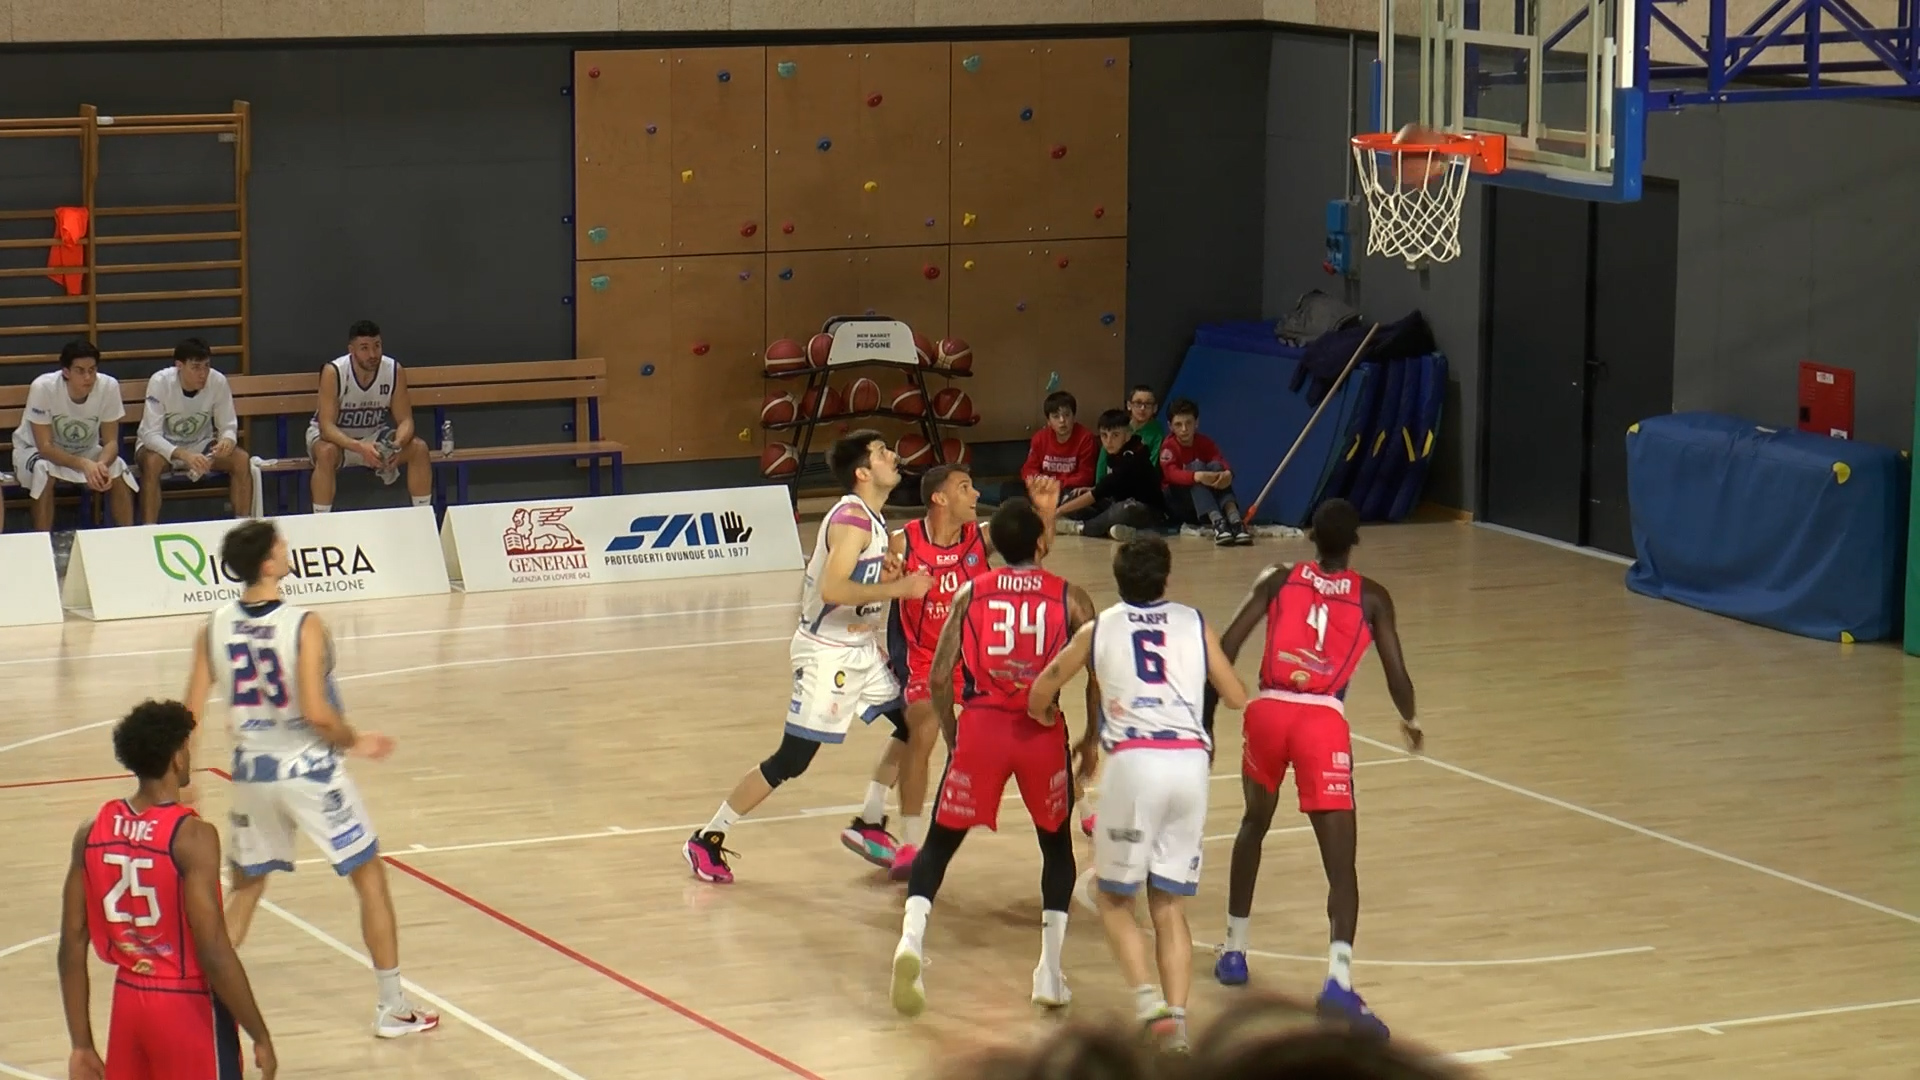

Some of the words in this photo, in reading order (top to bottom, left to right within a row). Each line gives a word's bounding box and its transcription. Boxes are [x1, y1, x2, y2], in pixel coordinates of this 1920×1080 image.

[380, 384, 390, 395] 10
[508, 554, 588, 573] GENERALI
[604, 552, 664, 566] PROTEGGERTI
[665, 550, 706, 562] OVUNQUE
[707, 549, 726, 559] DAL
[727, 547, 750, 558] 1977
[512, 574, 542, 583] AGENZIA
[552, 573, 577, 581] LOVERE
[940, 571, 958, 594] 10
[997, 574, 1043, 592] MOSS
[1127, 611, 1168, 624] CARPI
[987, 600, 1046, 656] 34
[1131, 629, 1168, 684] 6
[226, 642, 290, 707] 23
[102, 853, 162, 927] 25
